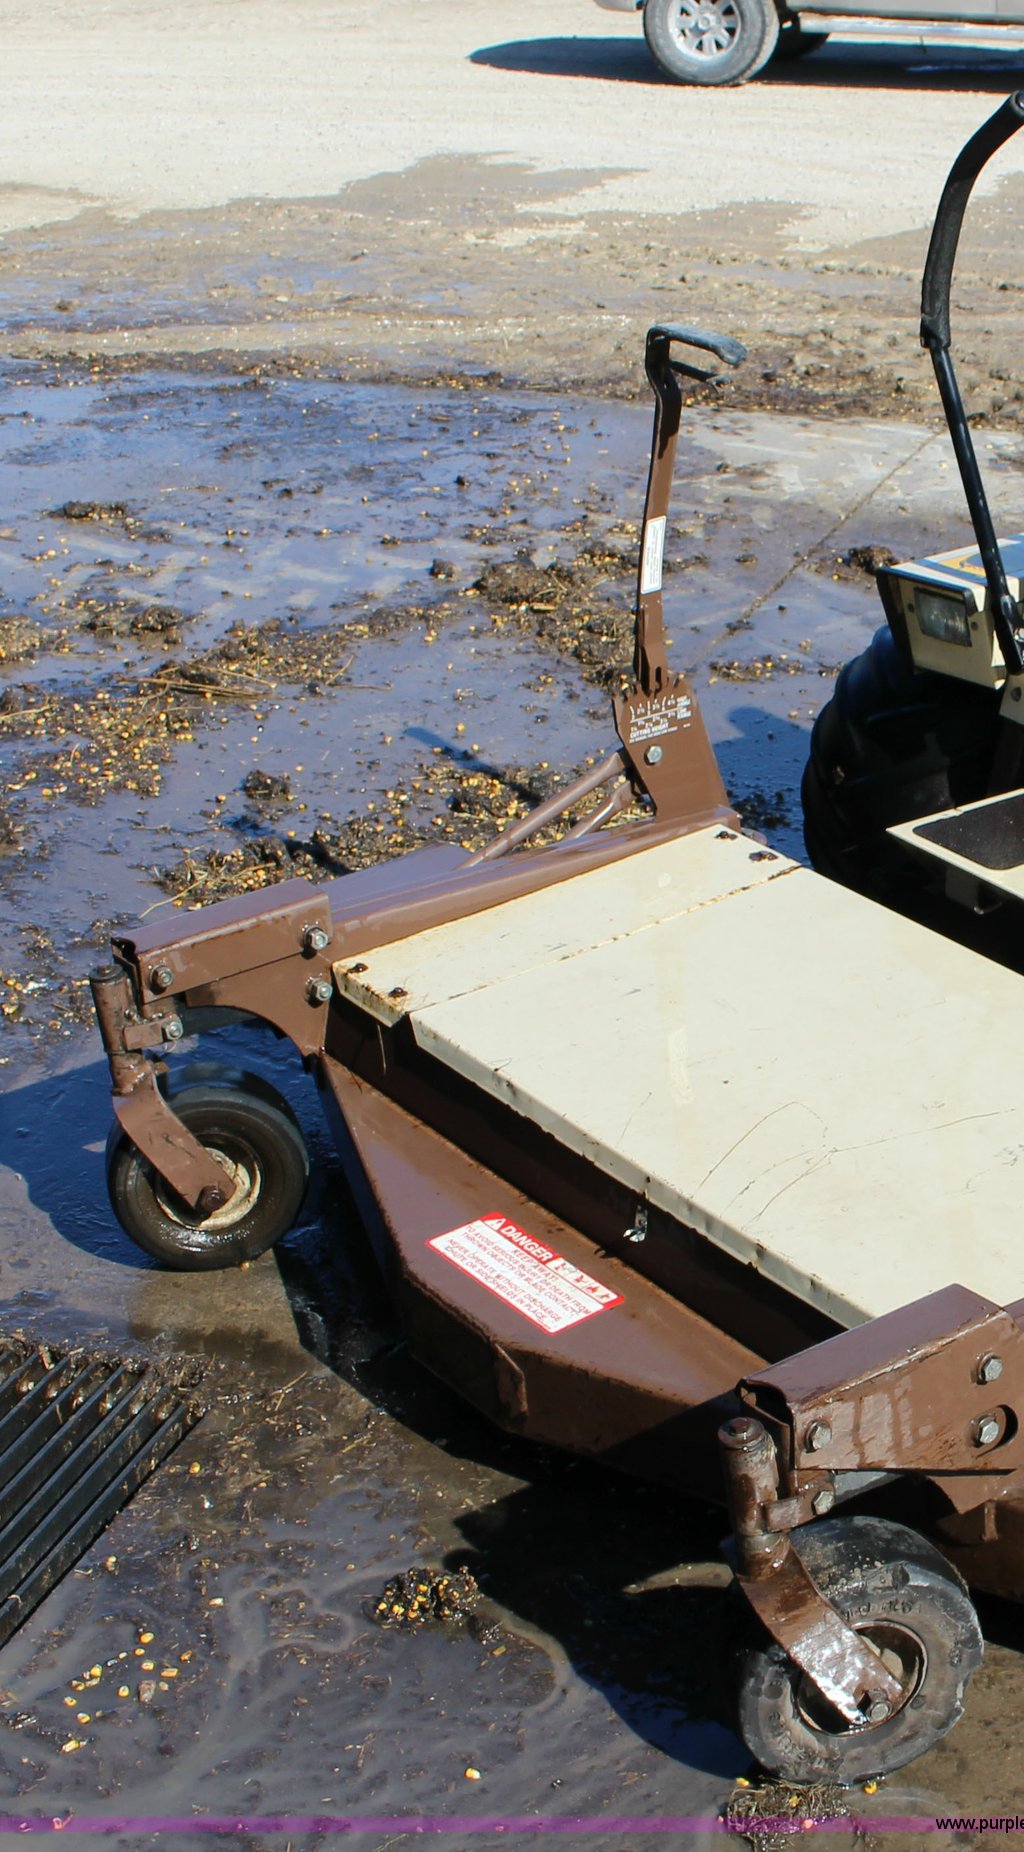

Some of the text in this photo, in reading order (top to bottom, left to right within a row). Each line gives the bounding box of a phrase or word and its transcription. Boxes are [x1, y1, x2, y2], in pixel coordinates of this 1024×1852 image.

[462, 1232, 489, 1252] THROWN
[486, 1250, 516, 1271] OBJECTS
[500, 1225, 553, 1262] DANGER
[511, 1249, 534, 1265] KEEP
[448, 1239, 562, 1321] NEVER OPERATE WITHOUT DISCHARGE
[473, 1231, 494, 1246] AVOID
[492, 1245, 520, 1265] SERIOUS
[549, 1285, 572, 1301] DEATH
[570, 1300, 592, 1315] FROM
